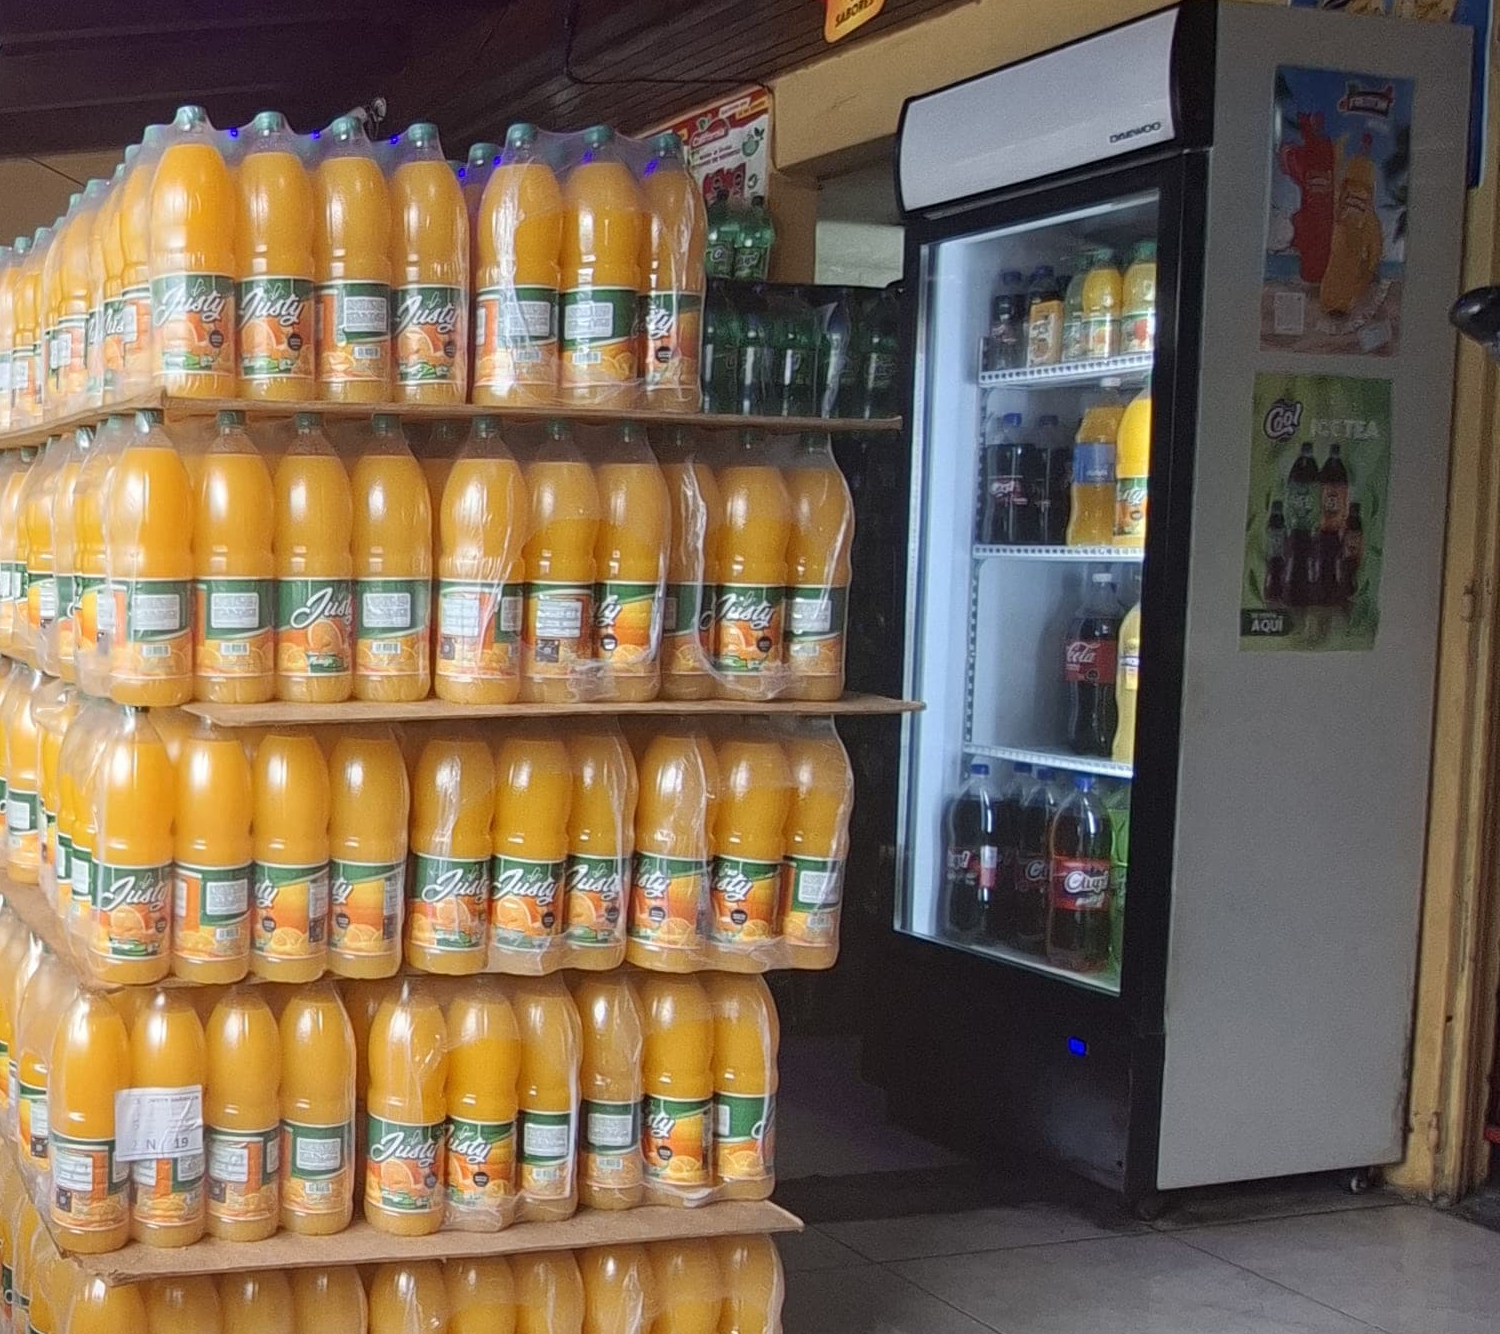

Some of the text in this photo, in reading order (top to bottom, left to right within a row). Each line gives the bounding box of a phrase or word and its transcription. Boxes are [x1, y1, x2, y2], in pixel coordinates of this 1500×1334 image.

[156, 286, 224, 326] Justy
[238, 285, 303, 328] Justy
[396, 294, 459, 336] Justy
[102, 874, 169, 912] Justy
[494, 863, 558, 905] Justy
[174, 1137, 189, 1149] 19
